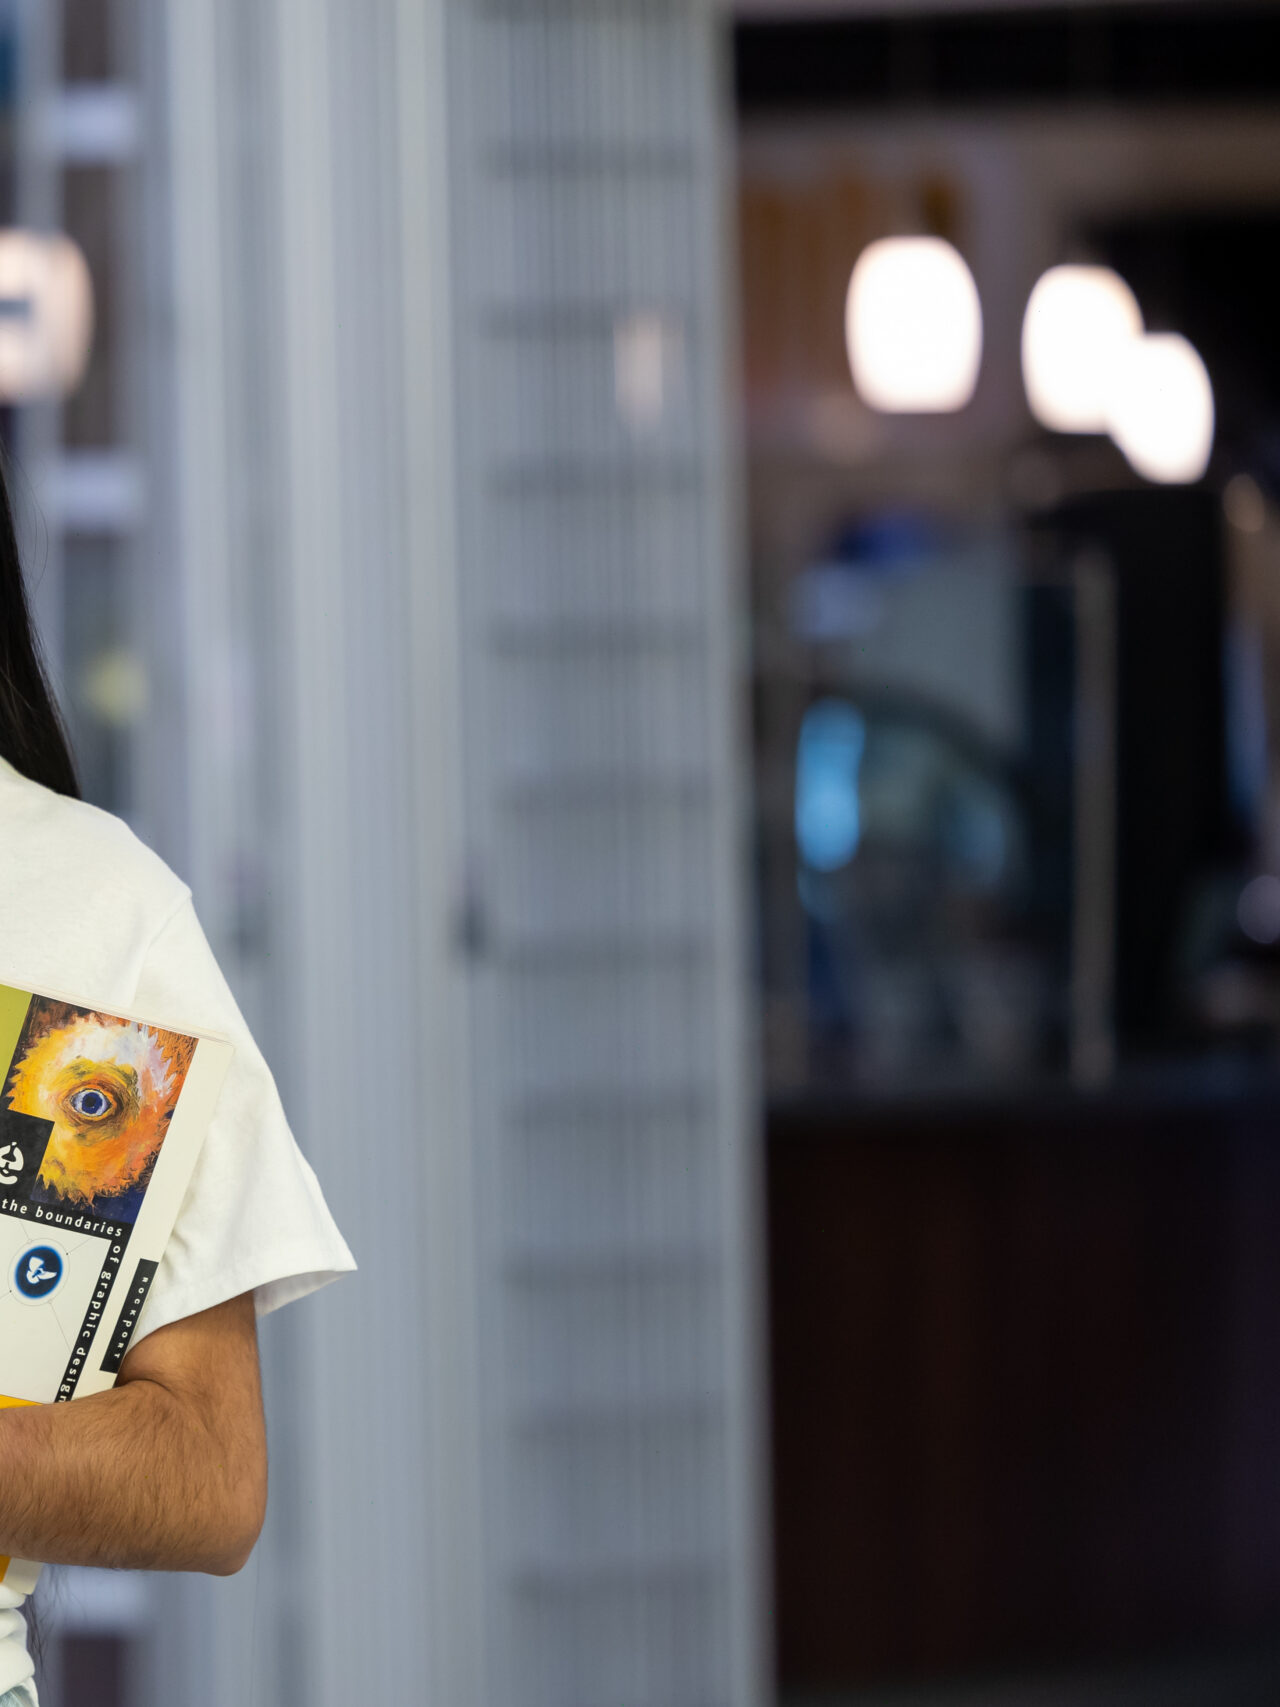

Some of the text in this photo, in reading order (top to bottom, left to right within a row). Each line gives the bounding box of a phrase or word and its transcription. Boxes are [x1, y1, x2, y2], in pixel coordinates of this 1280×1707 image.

[1, 1198, 28, 1215] the
[35, 1206, 123, 1237] boundaries
[58, 1245, 121, 1403] of graphic design
